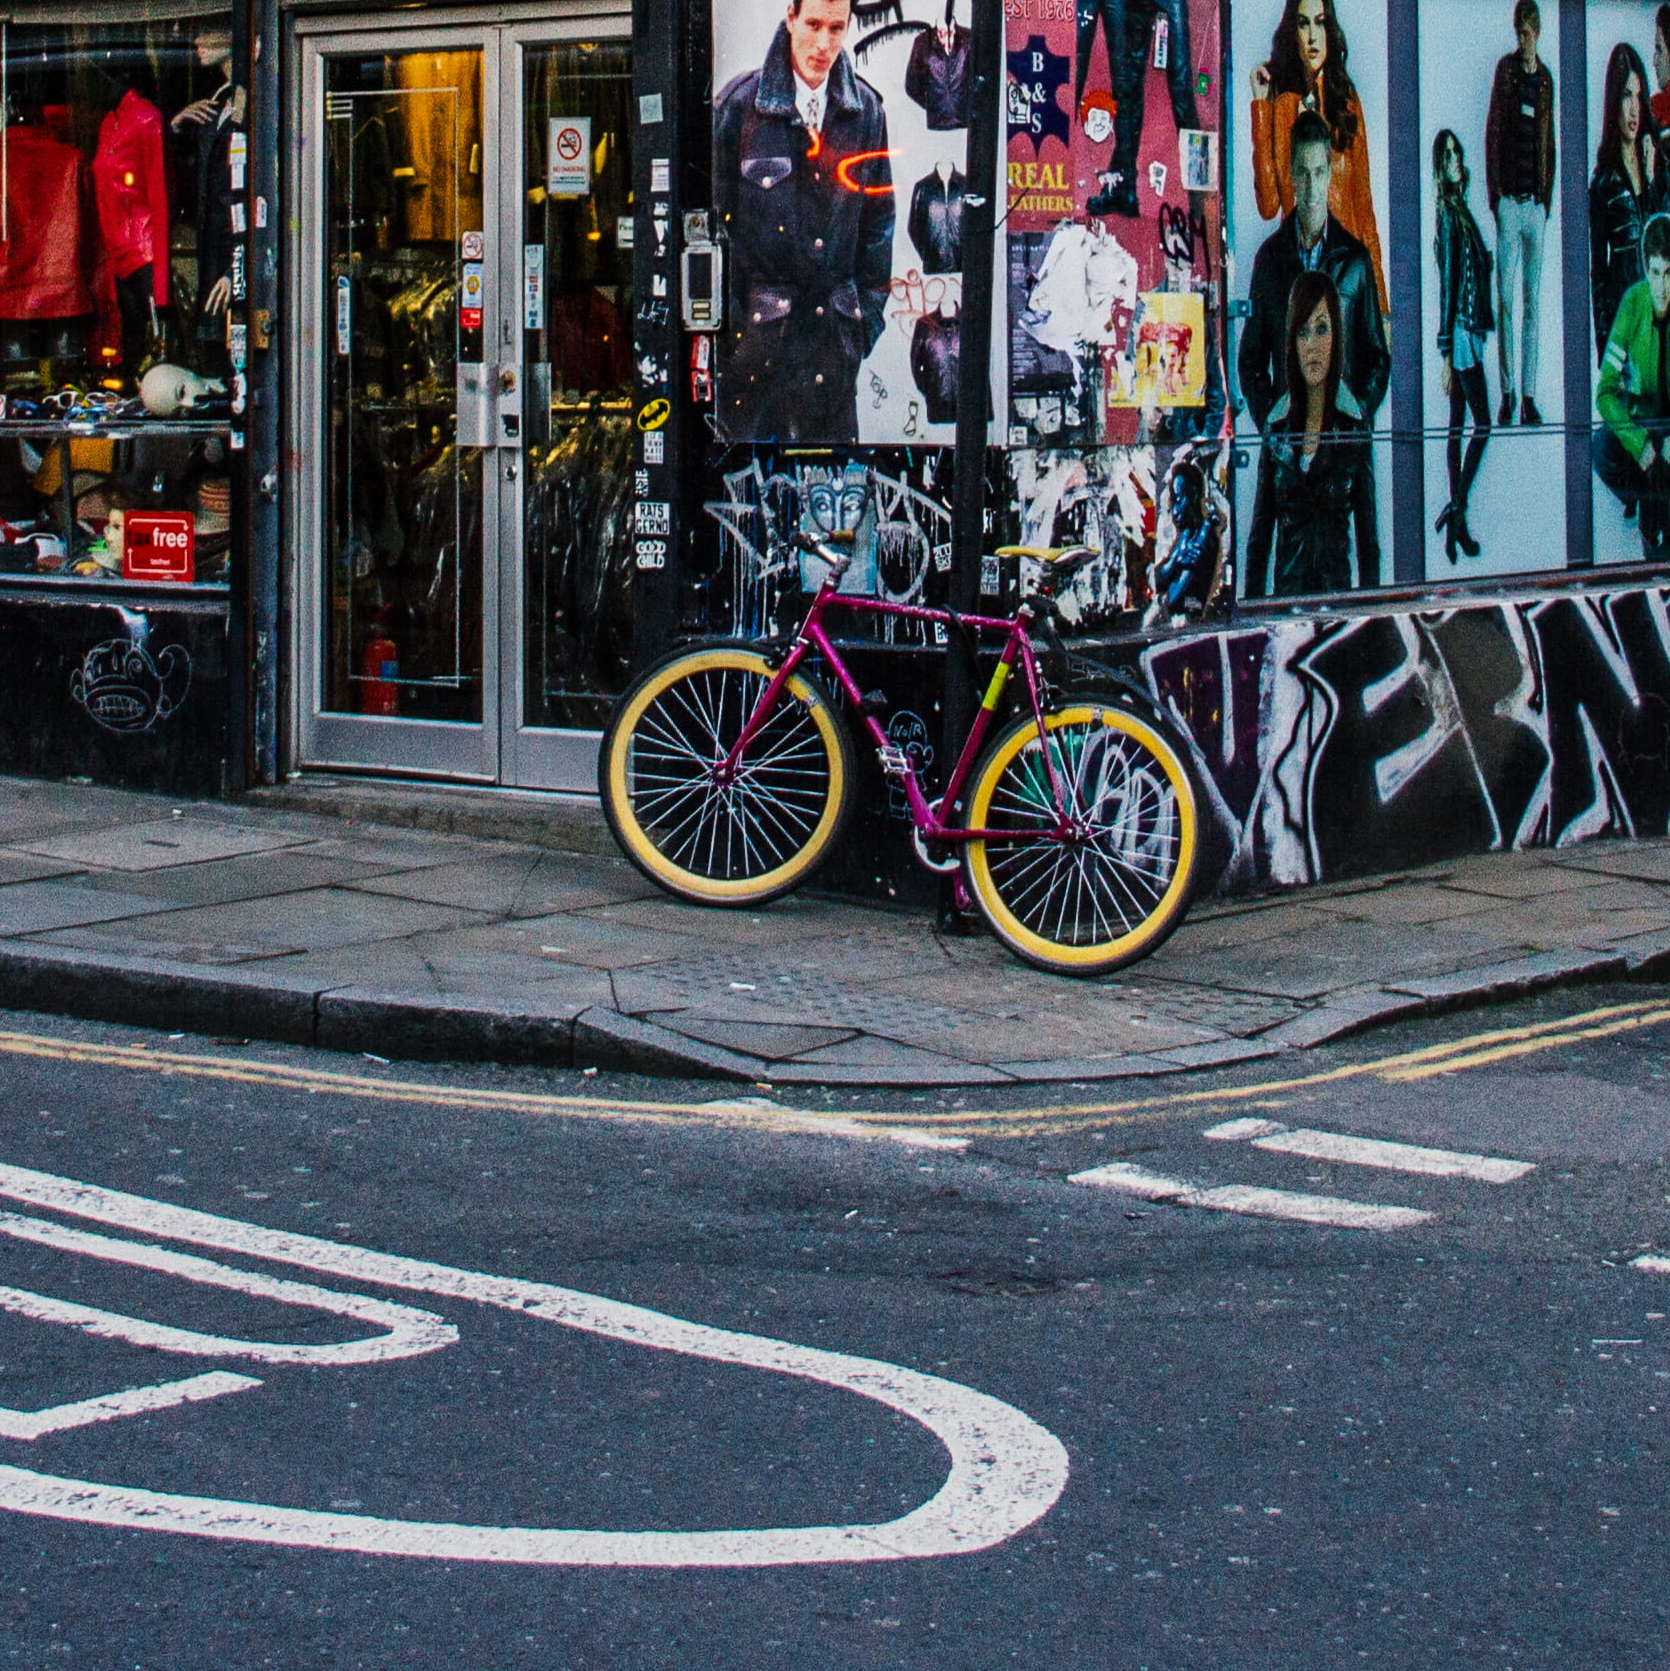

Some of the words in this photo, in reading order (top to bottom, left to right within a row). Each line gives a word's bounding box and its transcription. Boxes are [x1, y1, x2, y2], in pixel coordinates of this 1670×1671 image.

[1032, 52, 1044, 73] B
[1032, 83, 1046, 104] &
[1031, 112, 1042, 134] S
[1008, 161, 1070, 190] REAL
[639, 504, 664, 518] RATS
[152, 526, 188, 548] free
